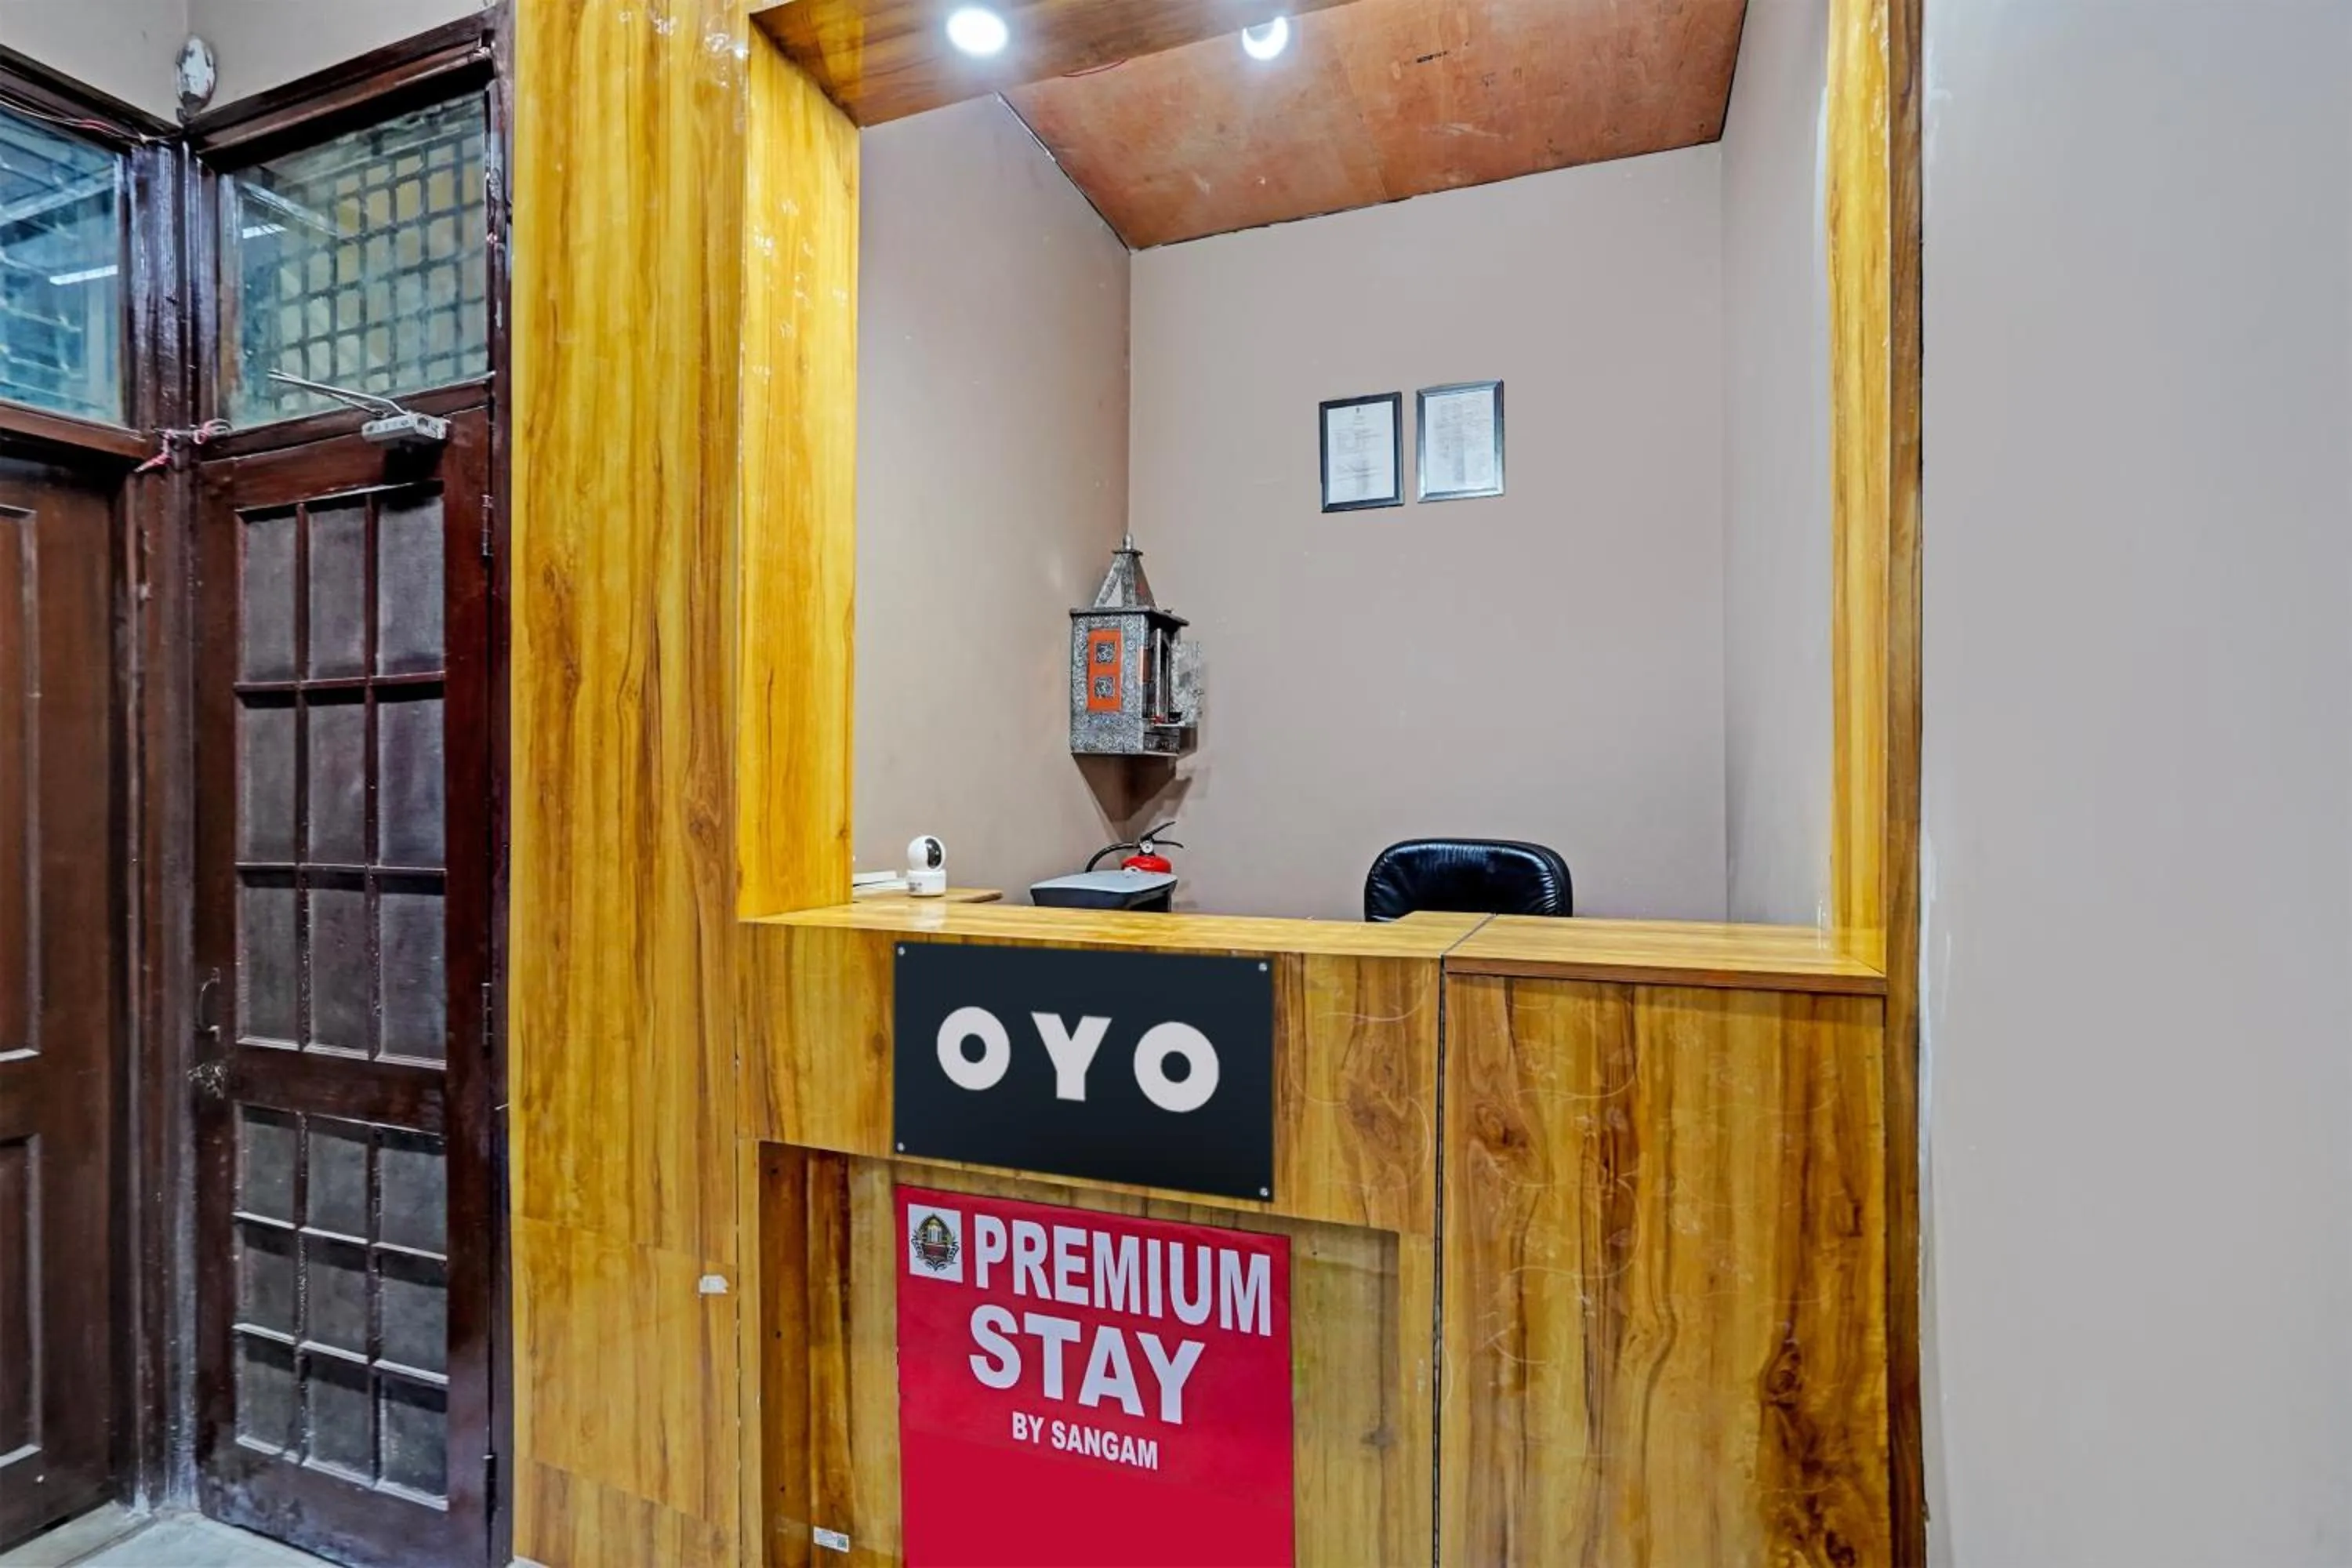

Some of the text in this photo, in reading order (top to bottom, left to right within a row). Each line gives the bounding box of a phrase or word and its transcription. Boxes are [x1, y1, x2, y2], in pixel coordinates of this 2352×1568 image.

[937, 1006, 1219, 1112] OYO
[975, 1214, 1271, 1337] PREMIUM
[969, 1304, 1205, 1425] STAY
[1012, 1411, 1158, 1470] BY SANGAM
